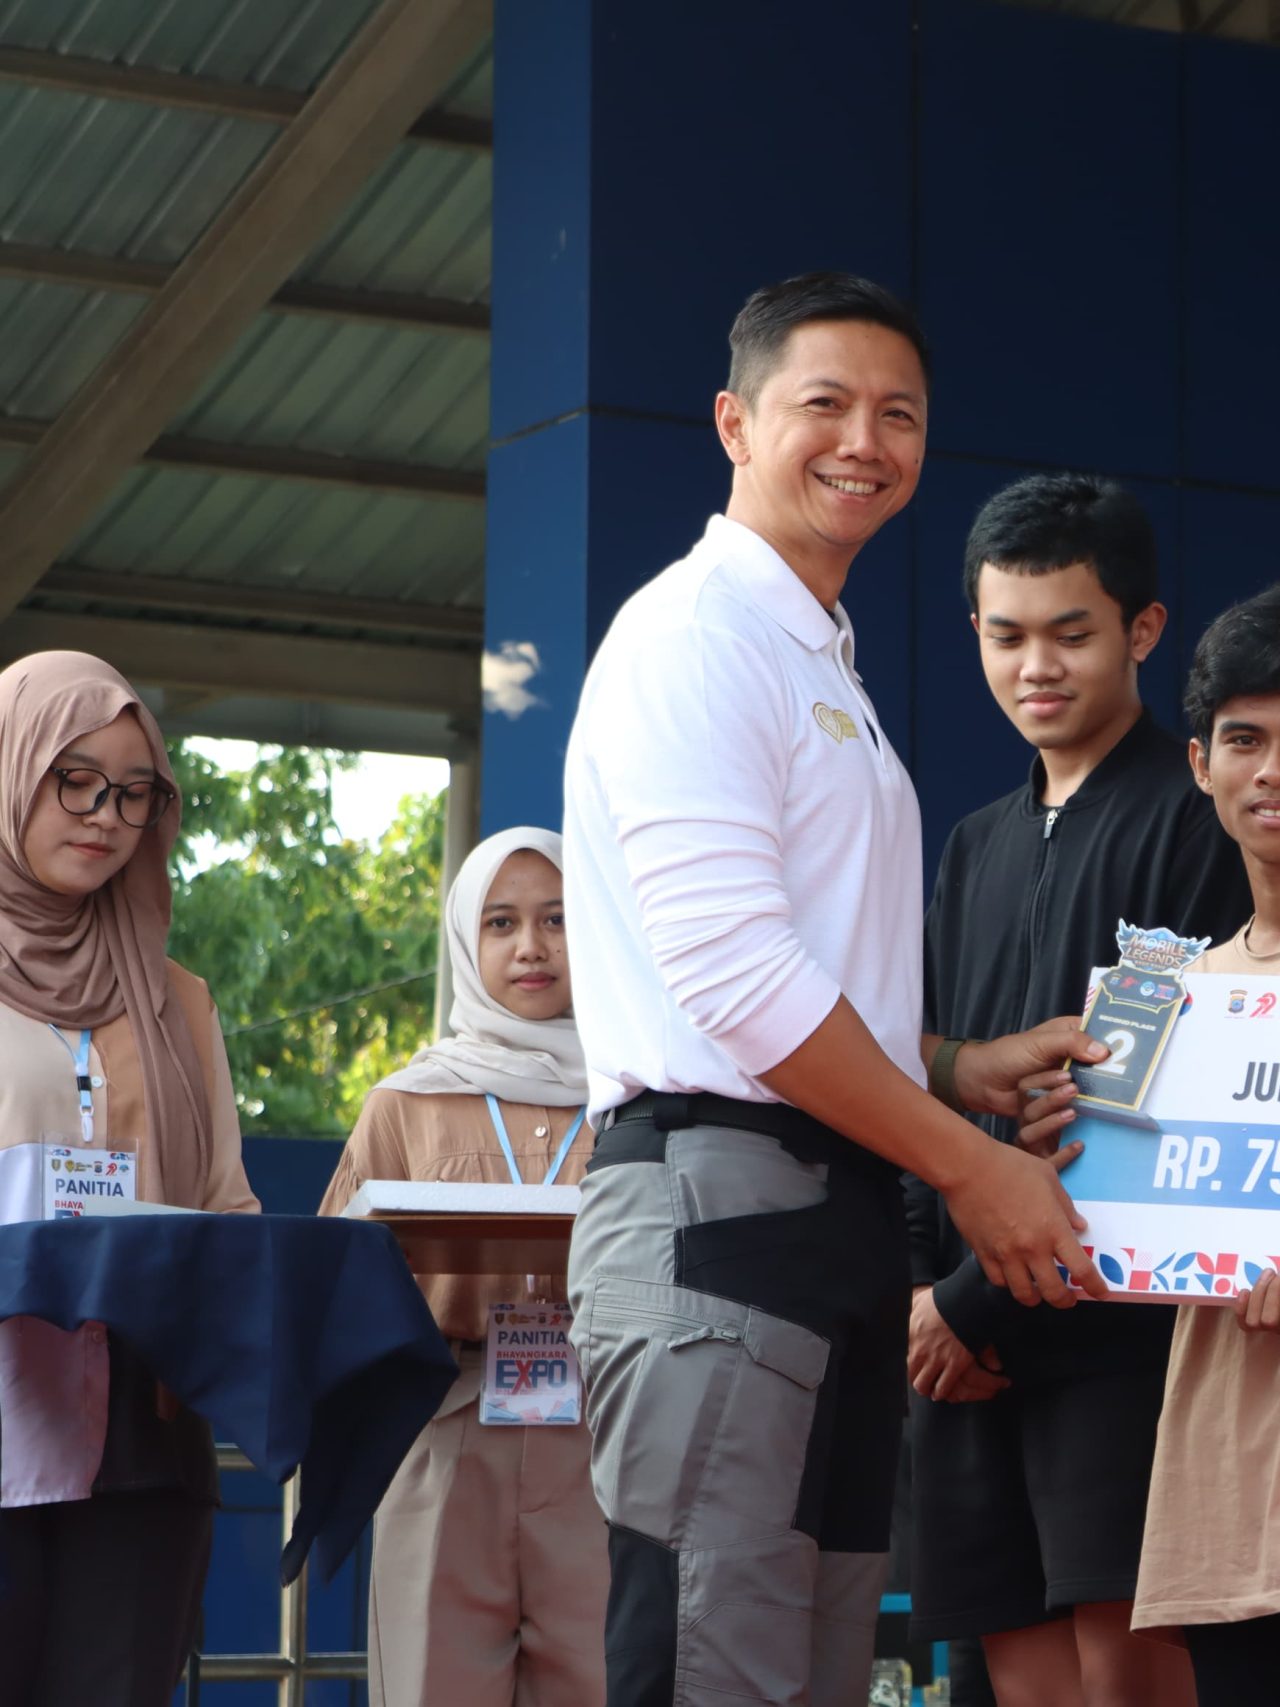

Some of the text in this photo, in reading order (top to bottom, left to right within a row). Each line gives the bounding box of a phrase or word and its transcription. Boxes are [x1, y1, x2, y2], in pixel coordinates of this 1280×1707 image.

[1127, 934, 1187, 957] MOBILE
[1125, 947, 1182, 968] LEGENDS
[1093, 1029, 1136, 1075] 2
[1153, 1134, 1222, 1191] RP.
[55, 1178, 124, 1197] PANITIA
[498, 1331, 568, 1345] PANITIA
[496, 1350, 567, 1359] BHAYANGKARA
[495, 1359, 568, 1395] EXPO
